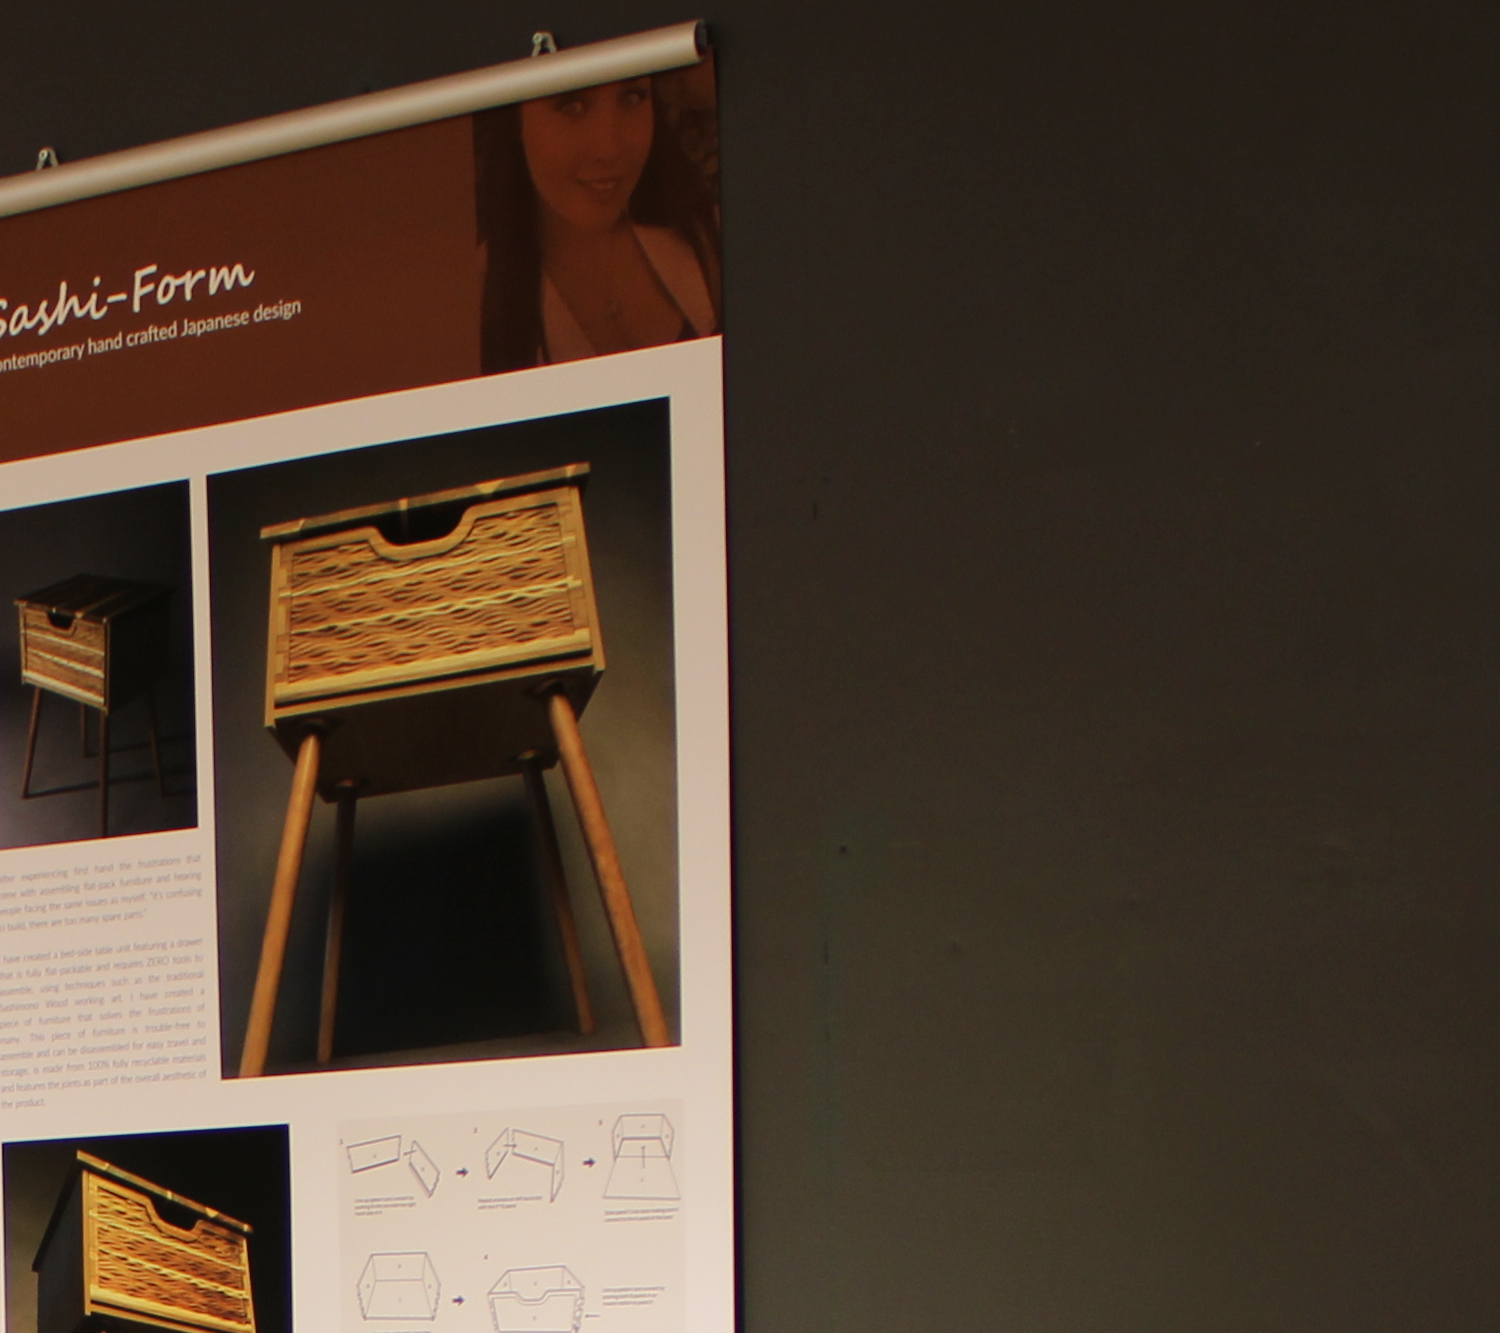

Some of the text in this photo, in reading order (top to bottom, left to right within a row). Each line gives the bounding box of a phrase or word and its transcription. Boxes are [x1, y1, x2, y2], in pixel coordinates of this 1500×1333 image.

[88, 331, 122, 355] hand
[126, 318, 177, 347] crafted
[181, 306, 249, 338] Japanese
[253, 299, 301, 323] design
